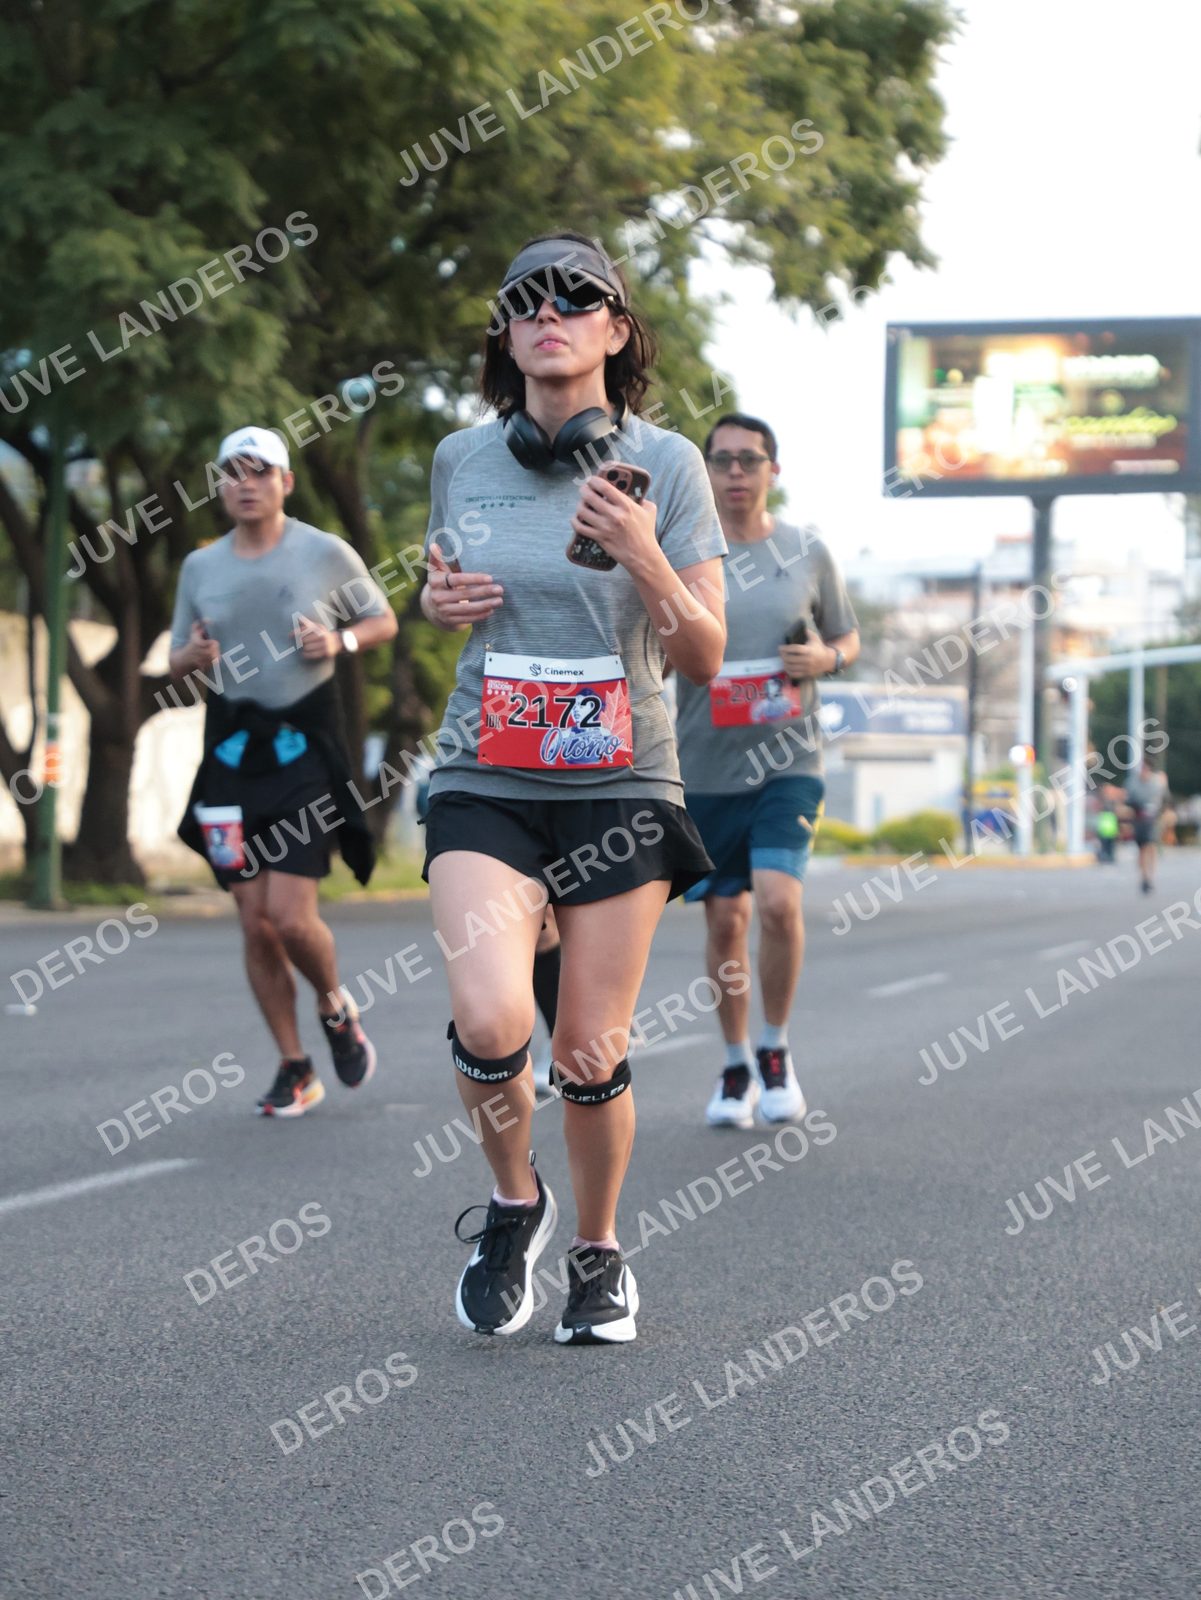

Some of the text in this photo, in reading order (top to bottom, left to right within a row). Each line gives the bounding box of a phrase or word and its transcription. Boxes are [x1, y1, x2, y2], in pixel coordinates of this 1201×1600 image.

[544, 667, 584, 677] Cinemex
[507, 692, 602, 729] 2172
[563, 1083, 625, 1102] MUELLER
